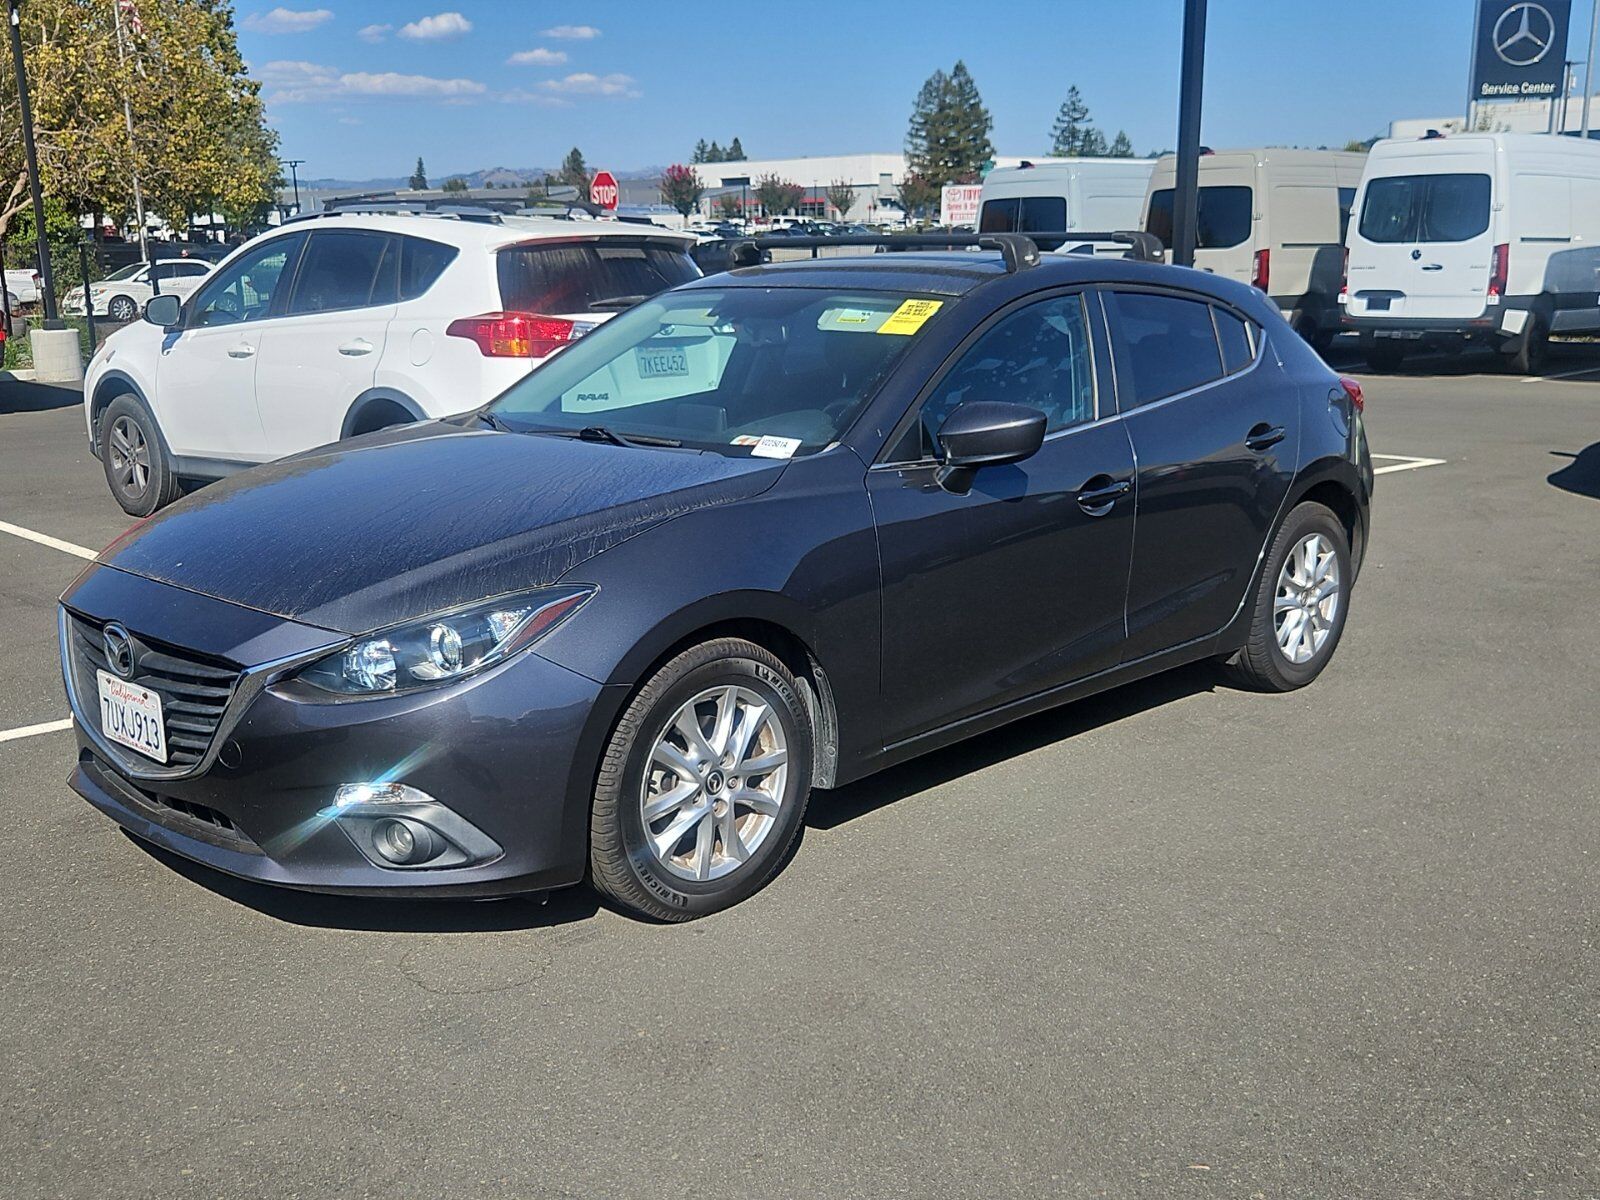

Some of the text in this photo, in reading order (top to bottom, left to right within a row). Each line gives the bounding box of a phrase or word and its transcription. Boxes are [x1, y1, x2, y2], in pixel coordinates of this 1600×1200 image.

[1481, 82, 1556, 95] Service Center
[592, 185, 616, 204] STOP
[640, 355, 686, 373] 7KEE452
[576, 392, 609, 402] RAV4
[110, 680, 146, 705] California
[103, 696, 160, 750] 7UXJ913
